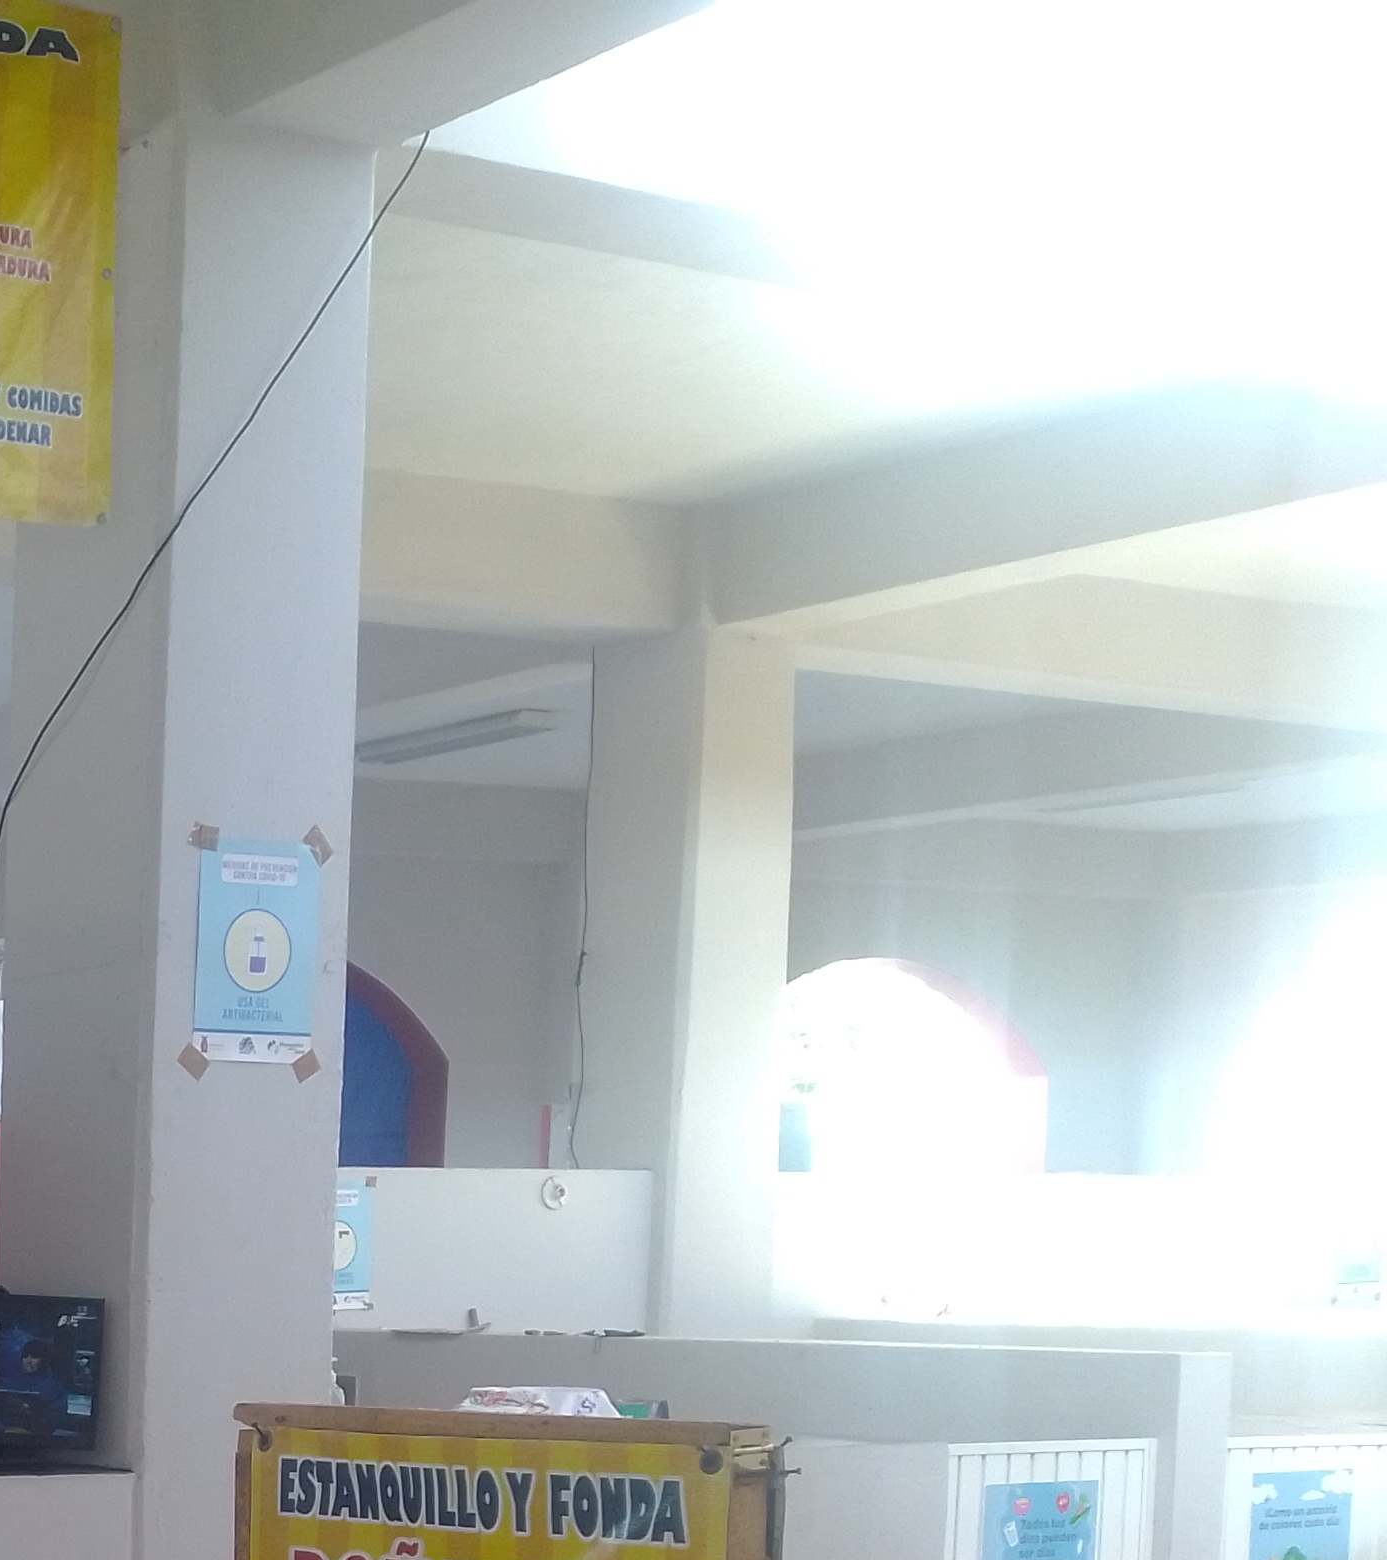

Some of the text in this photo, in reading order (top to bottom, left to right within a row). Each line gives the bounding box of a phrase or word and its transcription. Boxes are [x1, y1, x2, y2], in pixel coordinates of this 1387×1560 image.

[7, 386, 82, 417] COMIDAS
[279, 1457, 686, 1544] ESTANQUILLO Y FONDA
